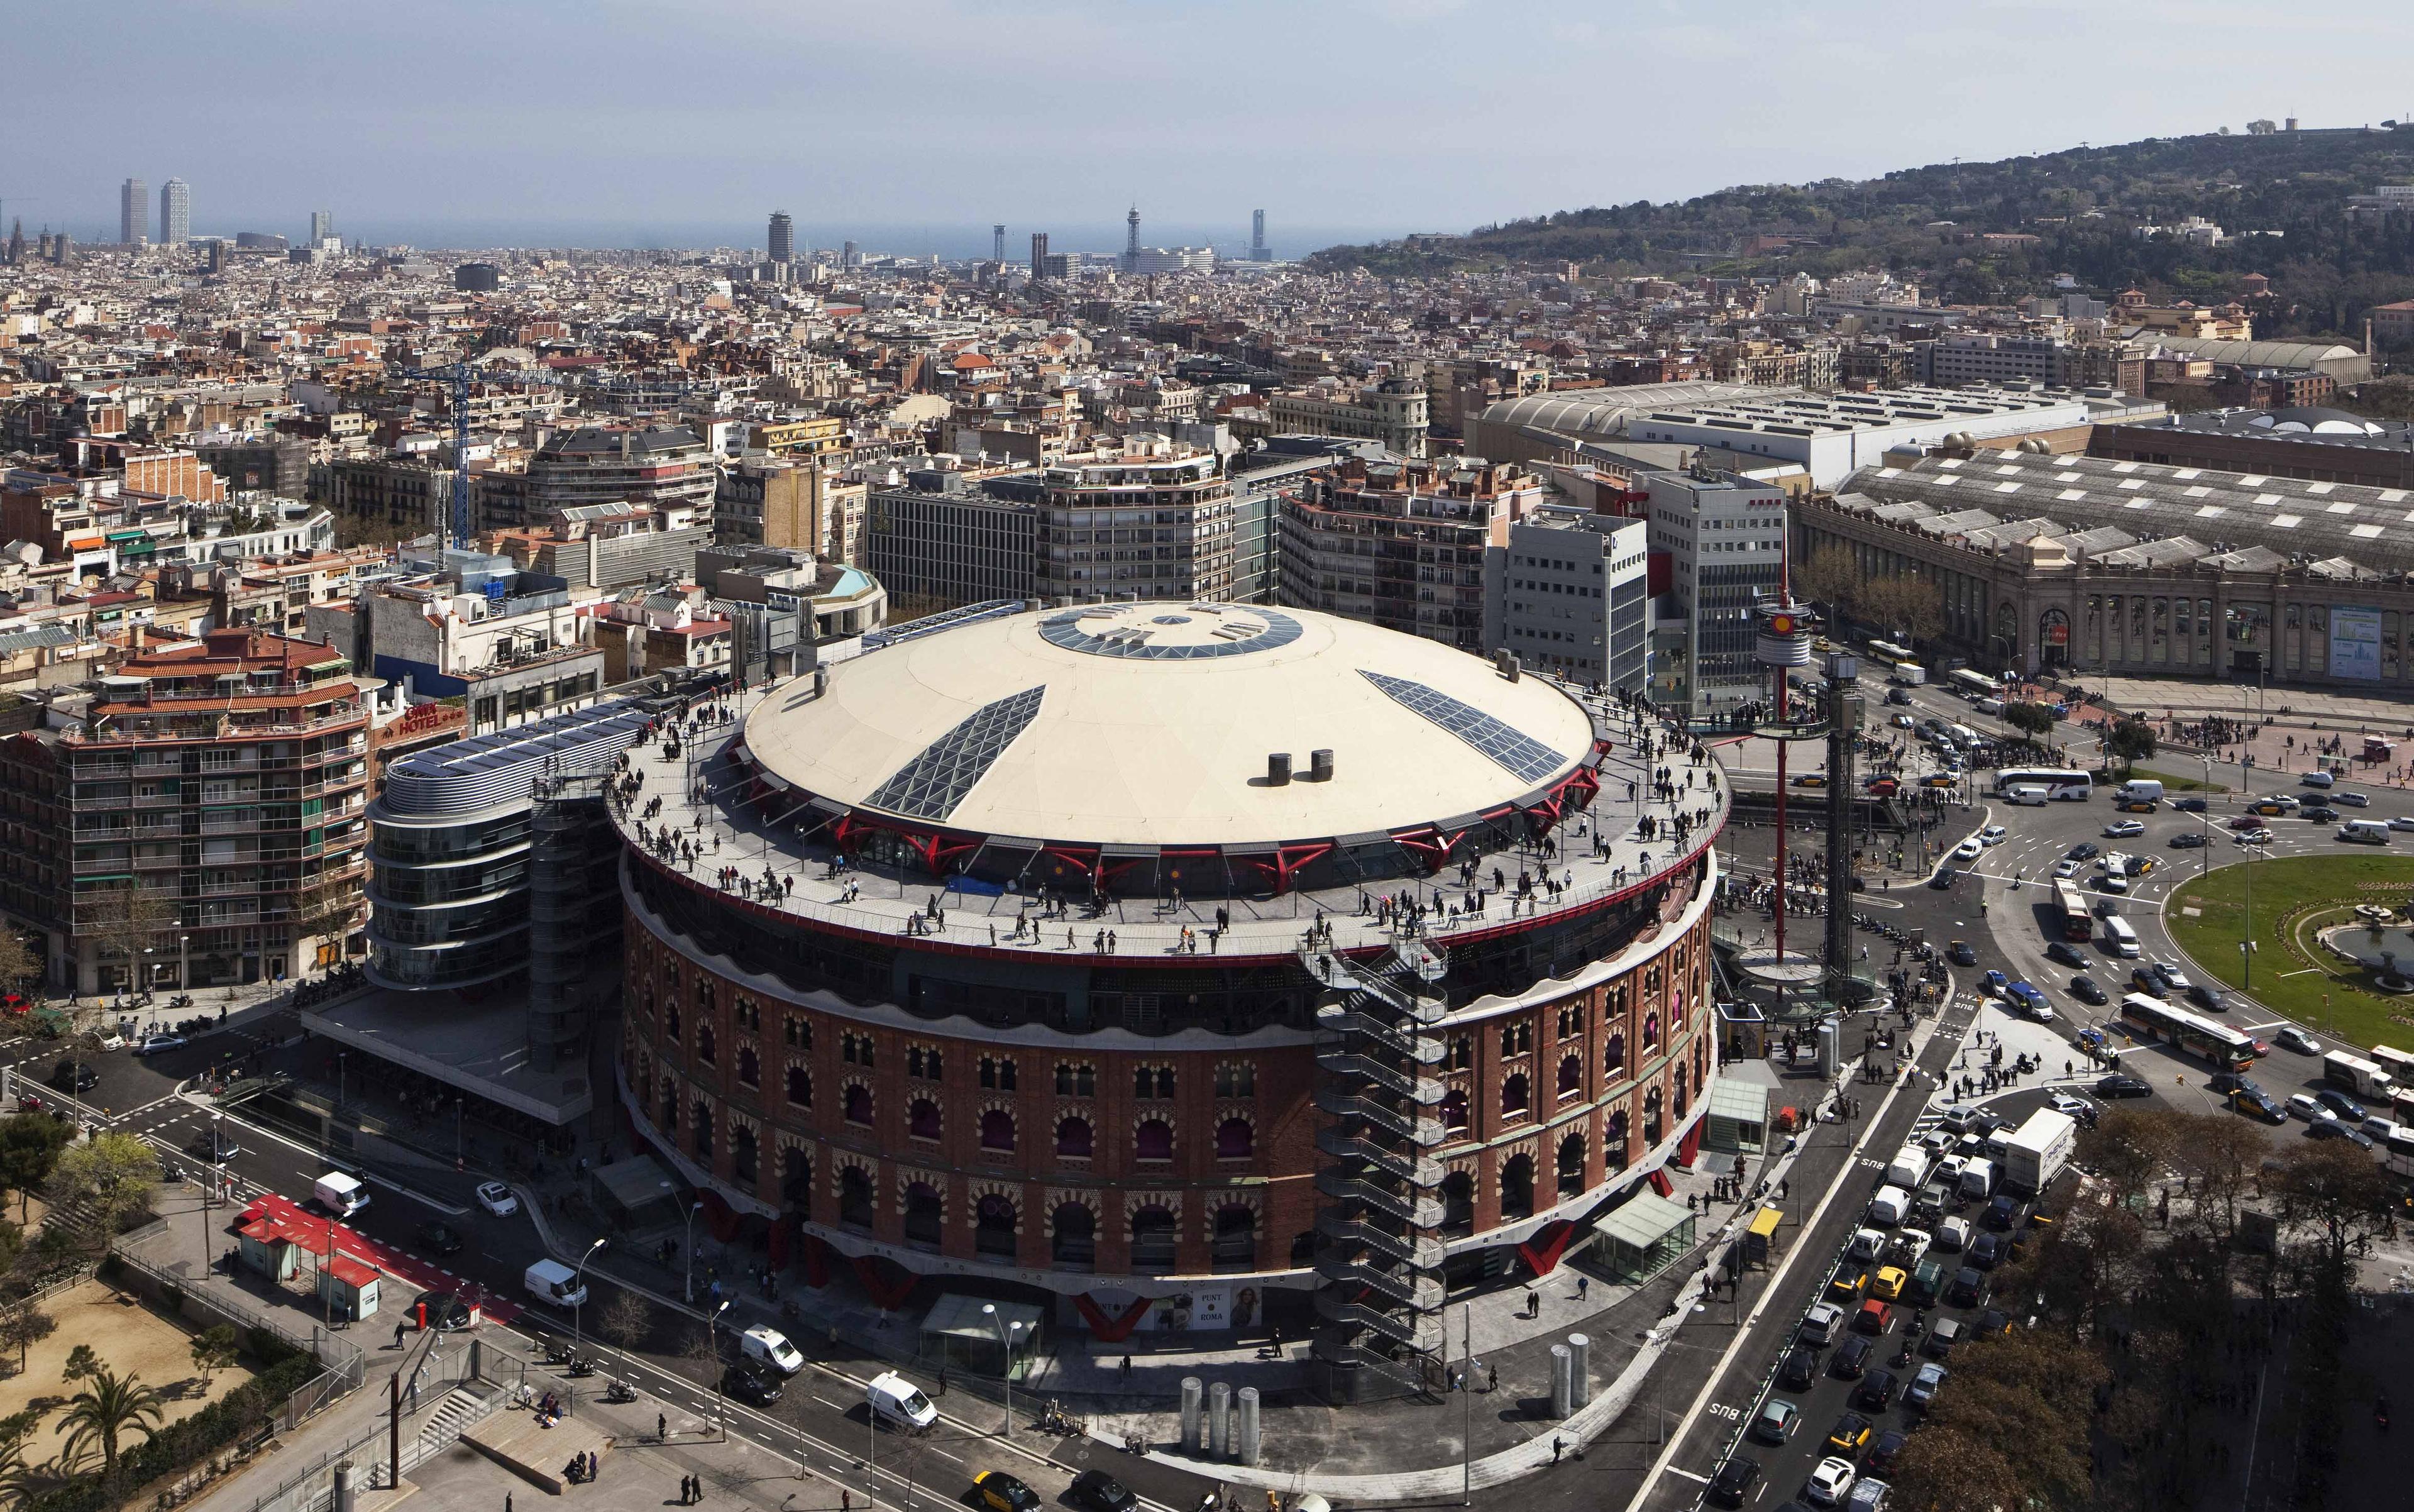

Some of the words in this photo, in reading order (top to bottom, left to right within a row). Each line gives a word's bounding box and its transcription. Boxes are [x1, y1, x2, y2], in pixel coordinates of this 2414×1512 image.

[399, 714, 443, 735] HOTEL
[1956, 993, 1980, 1002] TAXI
[1954, 1002, 1975, 1011] BUS
[1861, 1158, 1886, 1170] BUS
[1200, 1313, 1223, 1322] ROMA
[1709, 1403, 1740, 1421] BUS
